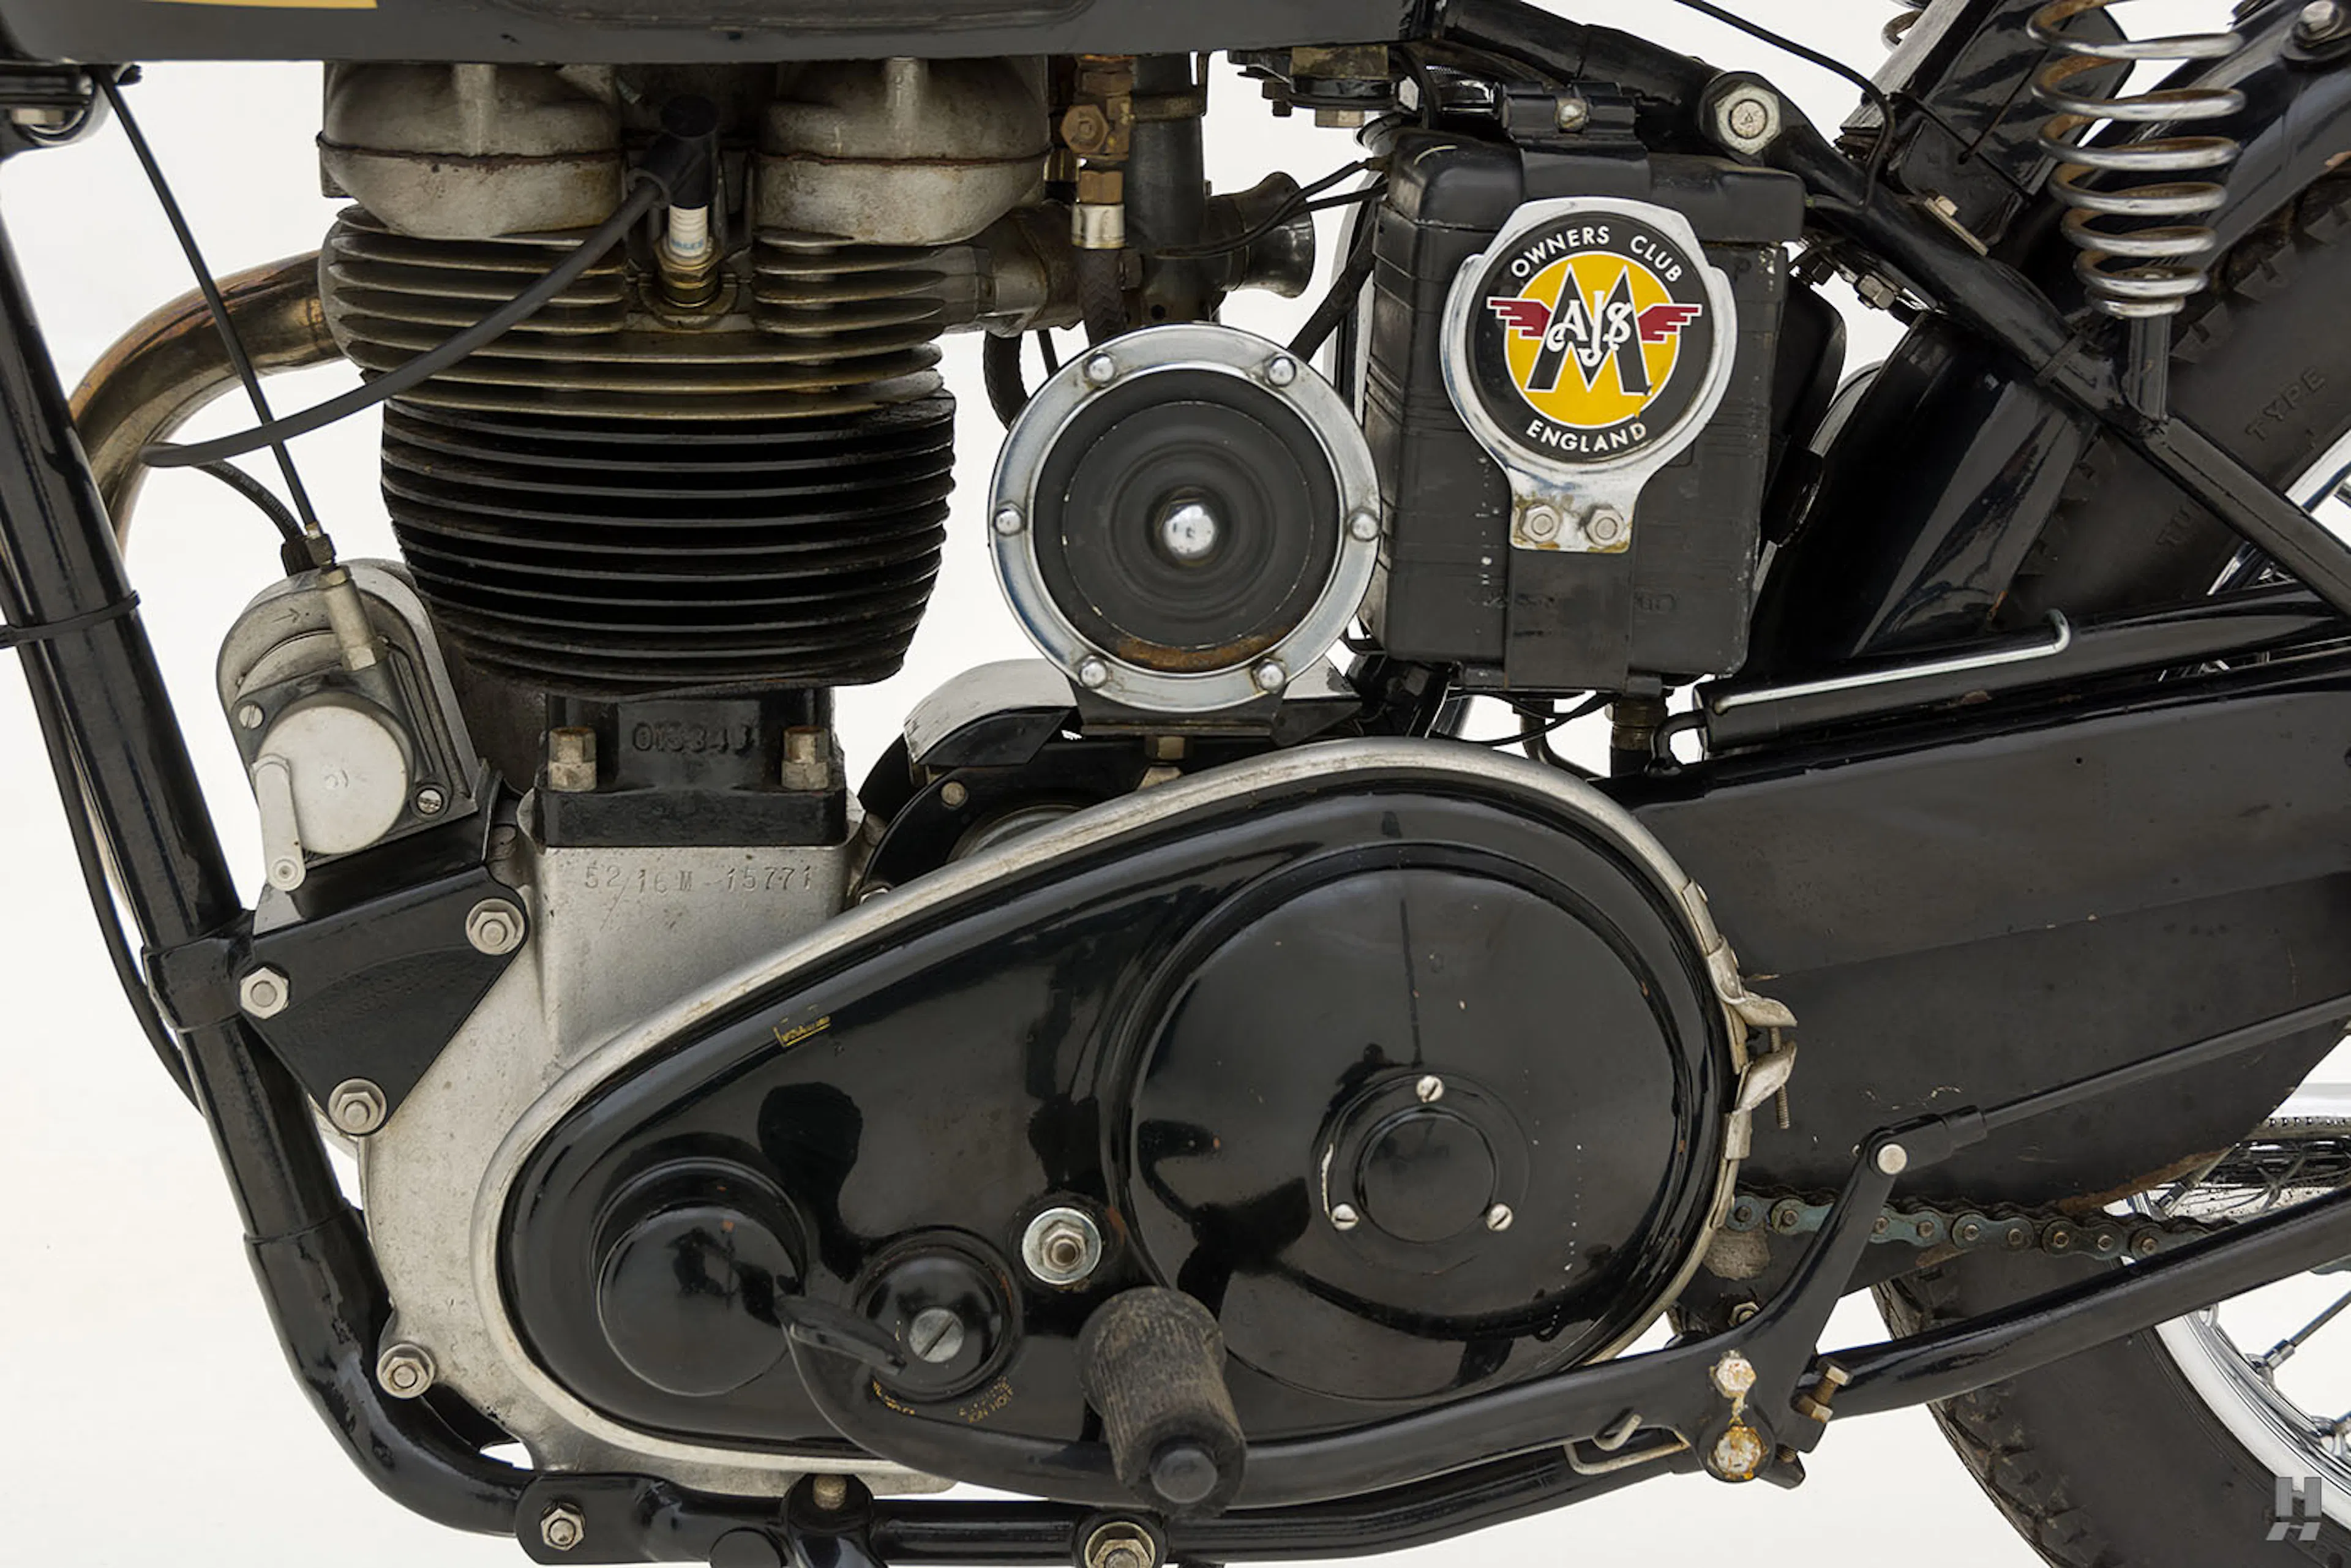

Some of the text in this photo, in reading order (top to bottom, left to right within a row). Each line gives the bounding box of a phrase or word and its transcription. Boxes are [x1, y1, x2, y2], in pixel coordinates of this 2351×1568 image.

[1510, 225, 1683, 283] OWNERS CLUB
[1547, 290, 1632, 367] AJS
[2244, 366, 2325, 441] TYPE
[1526, 419, 1647, 452] ENGLAND
[727, 865, 811, 892] 15771
